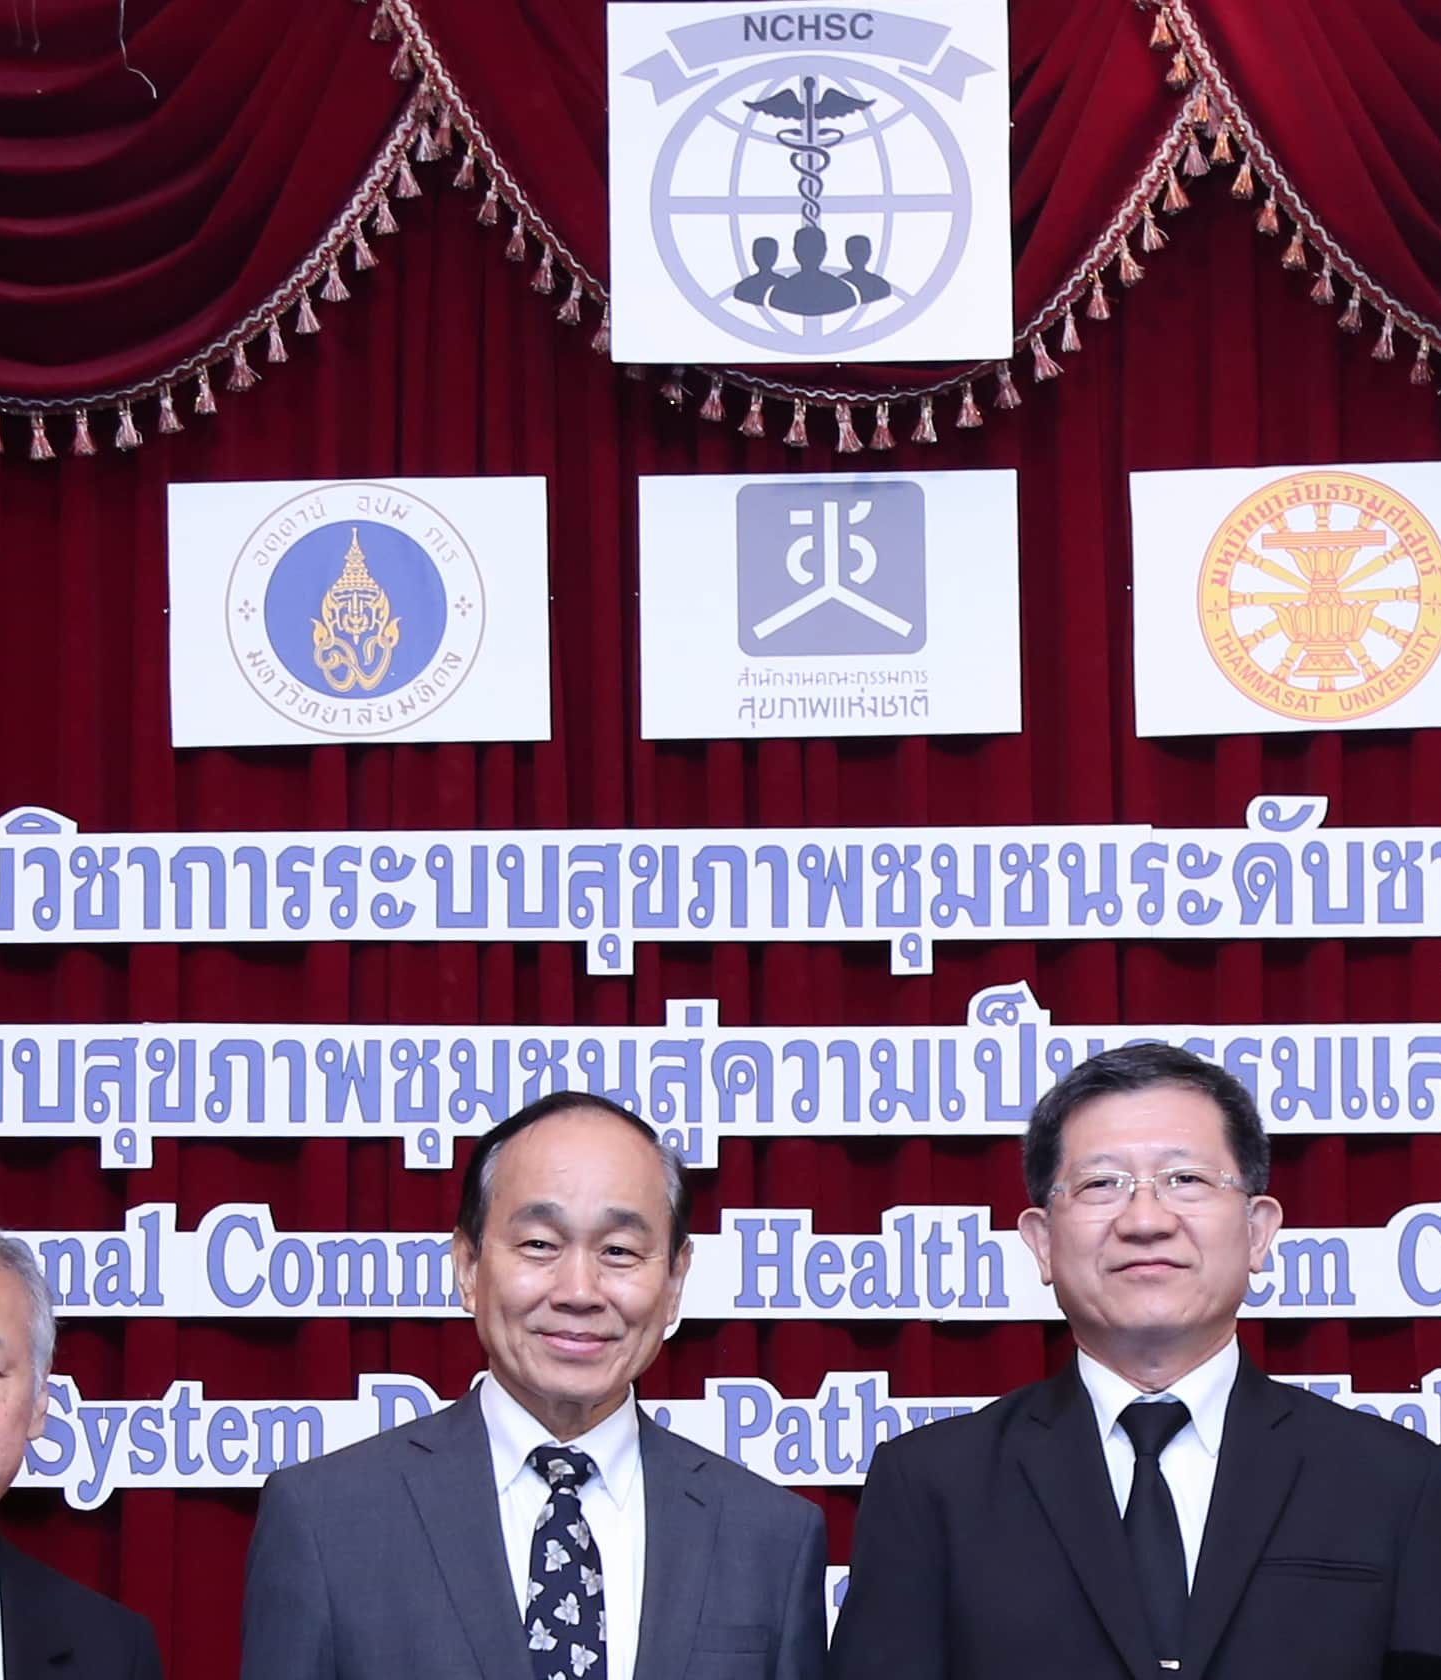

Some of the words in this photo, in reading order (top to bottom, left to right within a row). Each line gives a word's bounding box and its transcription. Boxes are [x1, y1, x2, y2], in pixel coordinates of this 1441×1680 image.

[743, 13, 875, 42] NCHSC
[245, 648, 464, 728] มหาวิทยาลัยมหิดล
[737, 666, 929, 687] สำนักงานคณะกรรมการ
[737, 688, 930, 729] สุขภาพแห่งชาติ
[1214, 629, 1321, 713] THAMMASAT
[1338, 628, 1439, 711] UNIVERSITY
[733, 1214, 1009, 1310] Health
[26, 1382, 324, 1502] System
